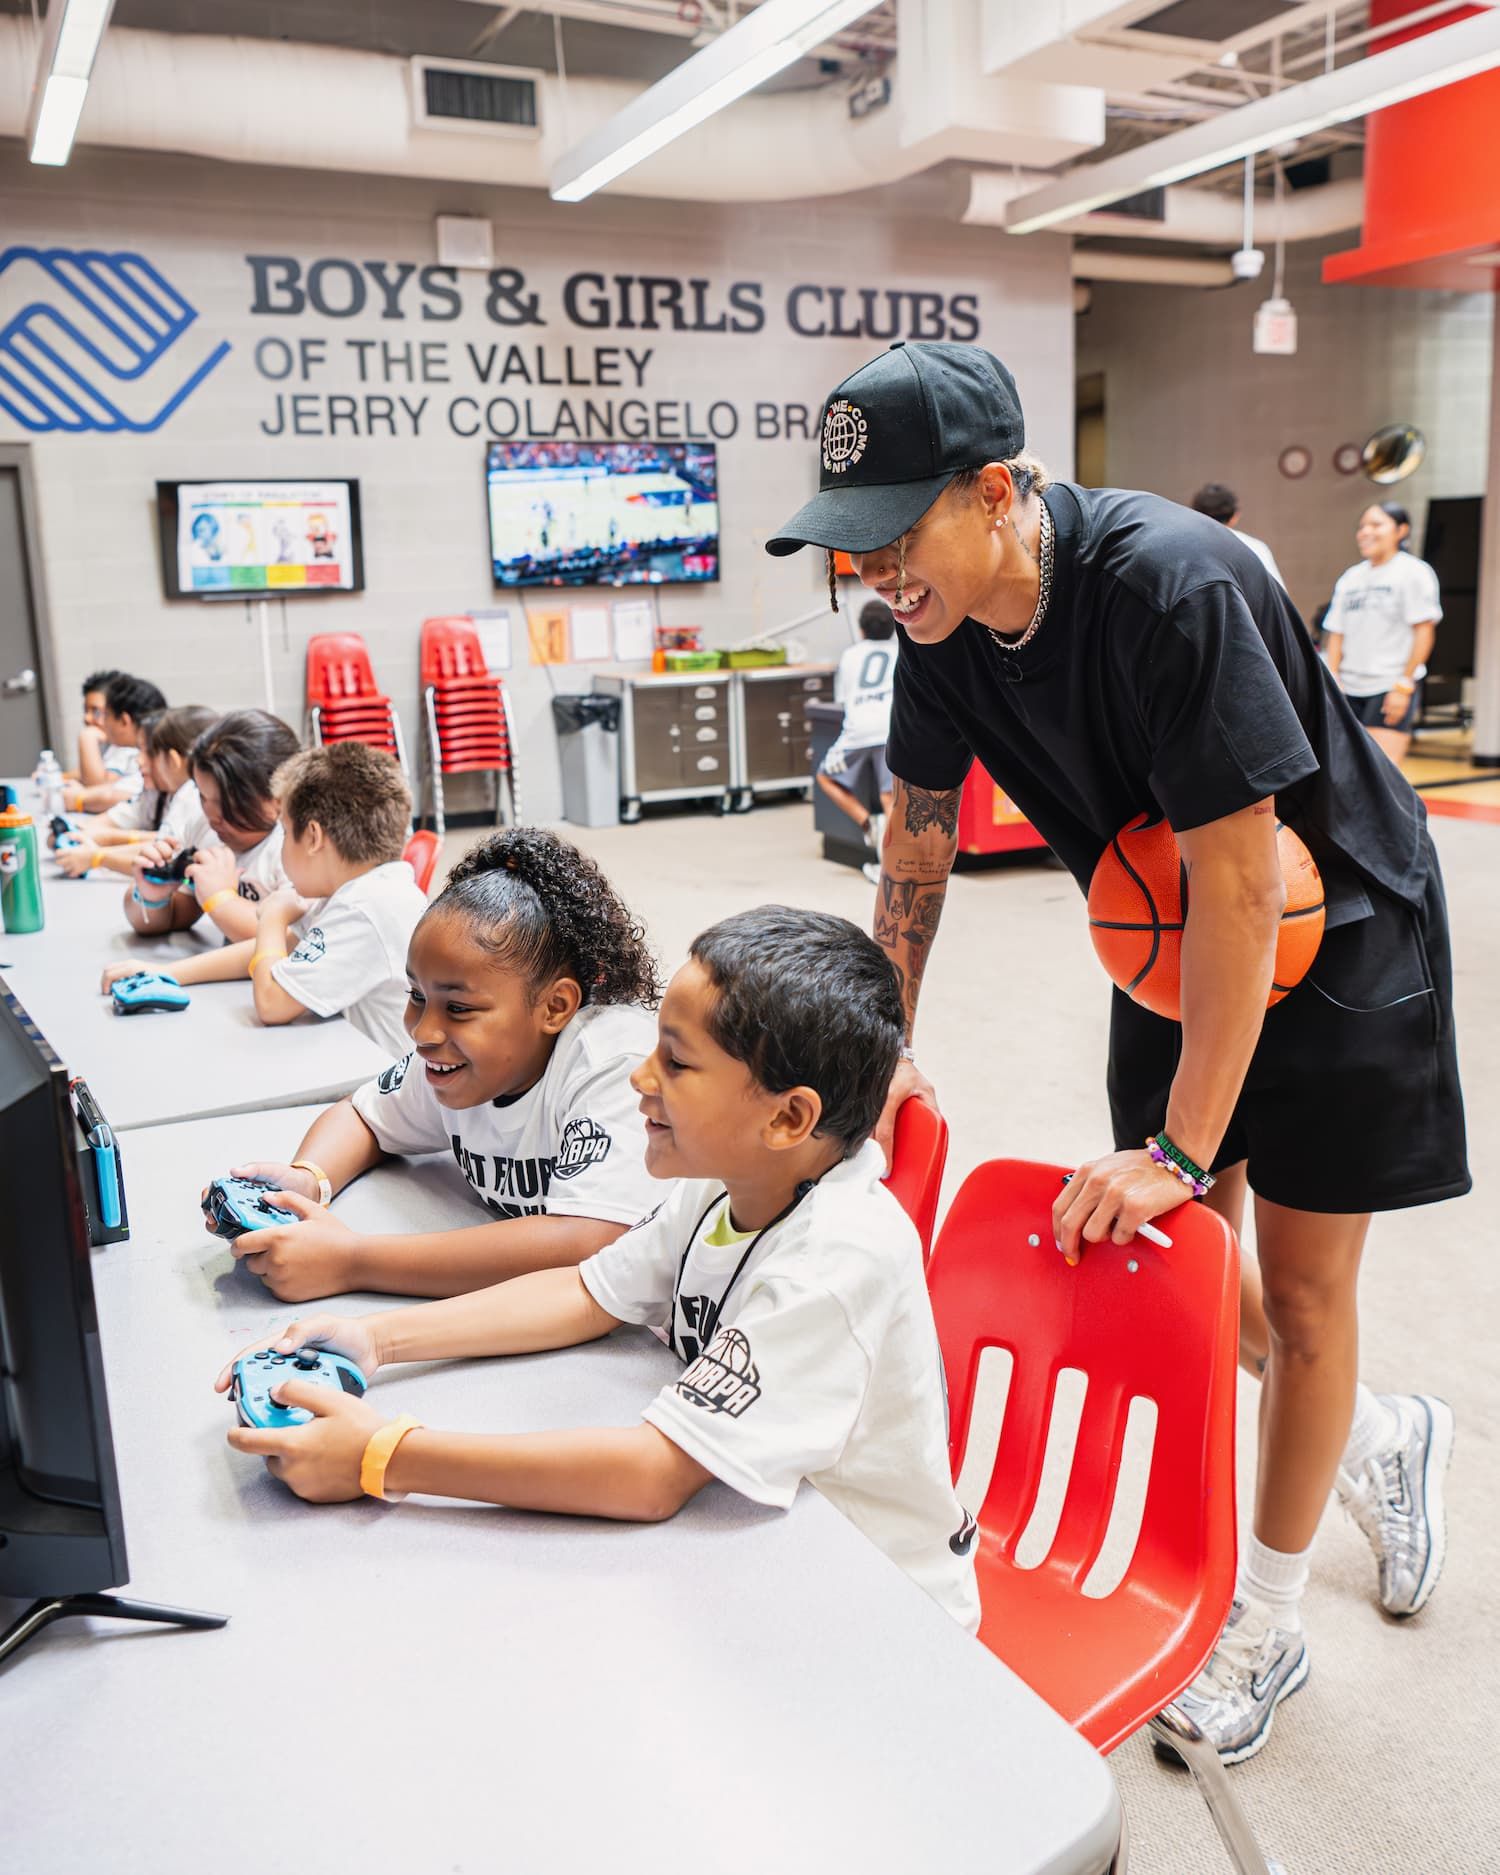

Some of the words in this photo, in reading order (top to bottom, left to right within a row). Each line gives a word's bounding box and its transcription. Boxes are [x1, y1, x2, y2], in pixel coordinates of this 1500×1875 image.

[245, 254, 462, 322] BOYS
[485, 267, 547, 326] &
[563, 272, 766, 333] GIRLS
[786, 285, 980, 341] CLUBS
[254, 336, 327, 381] OF
[345, 339, 450, 383] THE
[466, 343, 654, 388] VALLEY
[260, 394, 429, 437] JERRY
[448, 396, 739, 440] COLANGELO
[830, 400, 849, 414] WE
[850, 407, 869, 464] COME
[831, 461, 847, 474] IN
